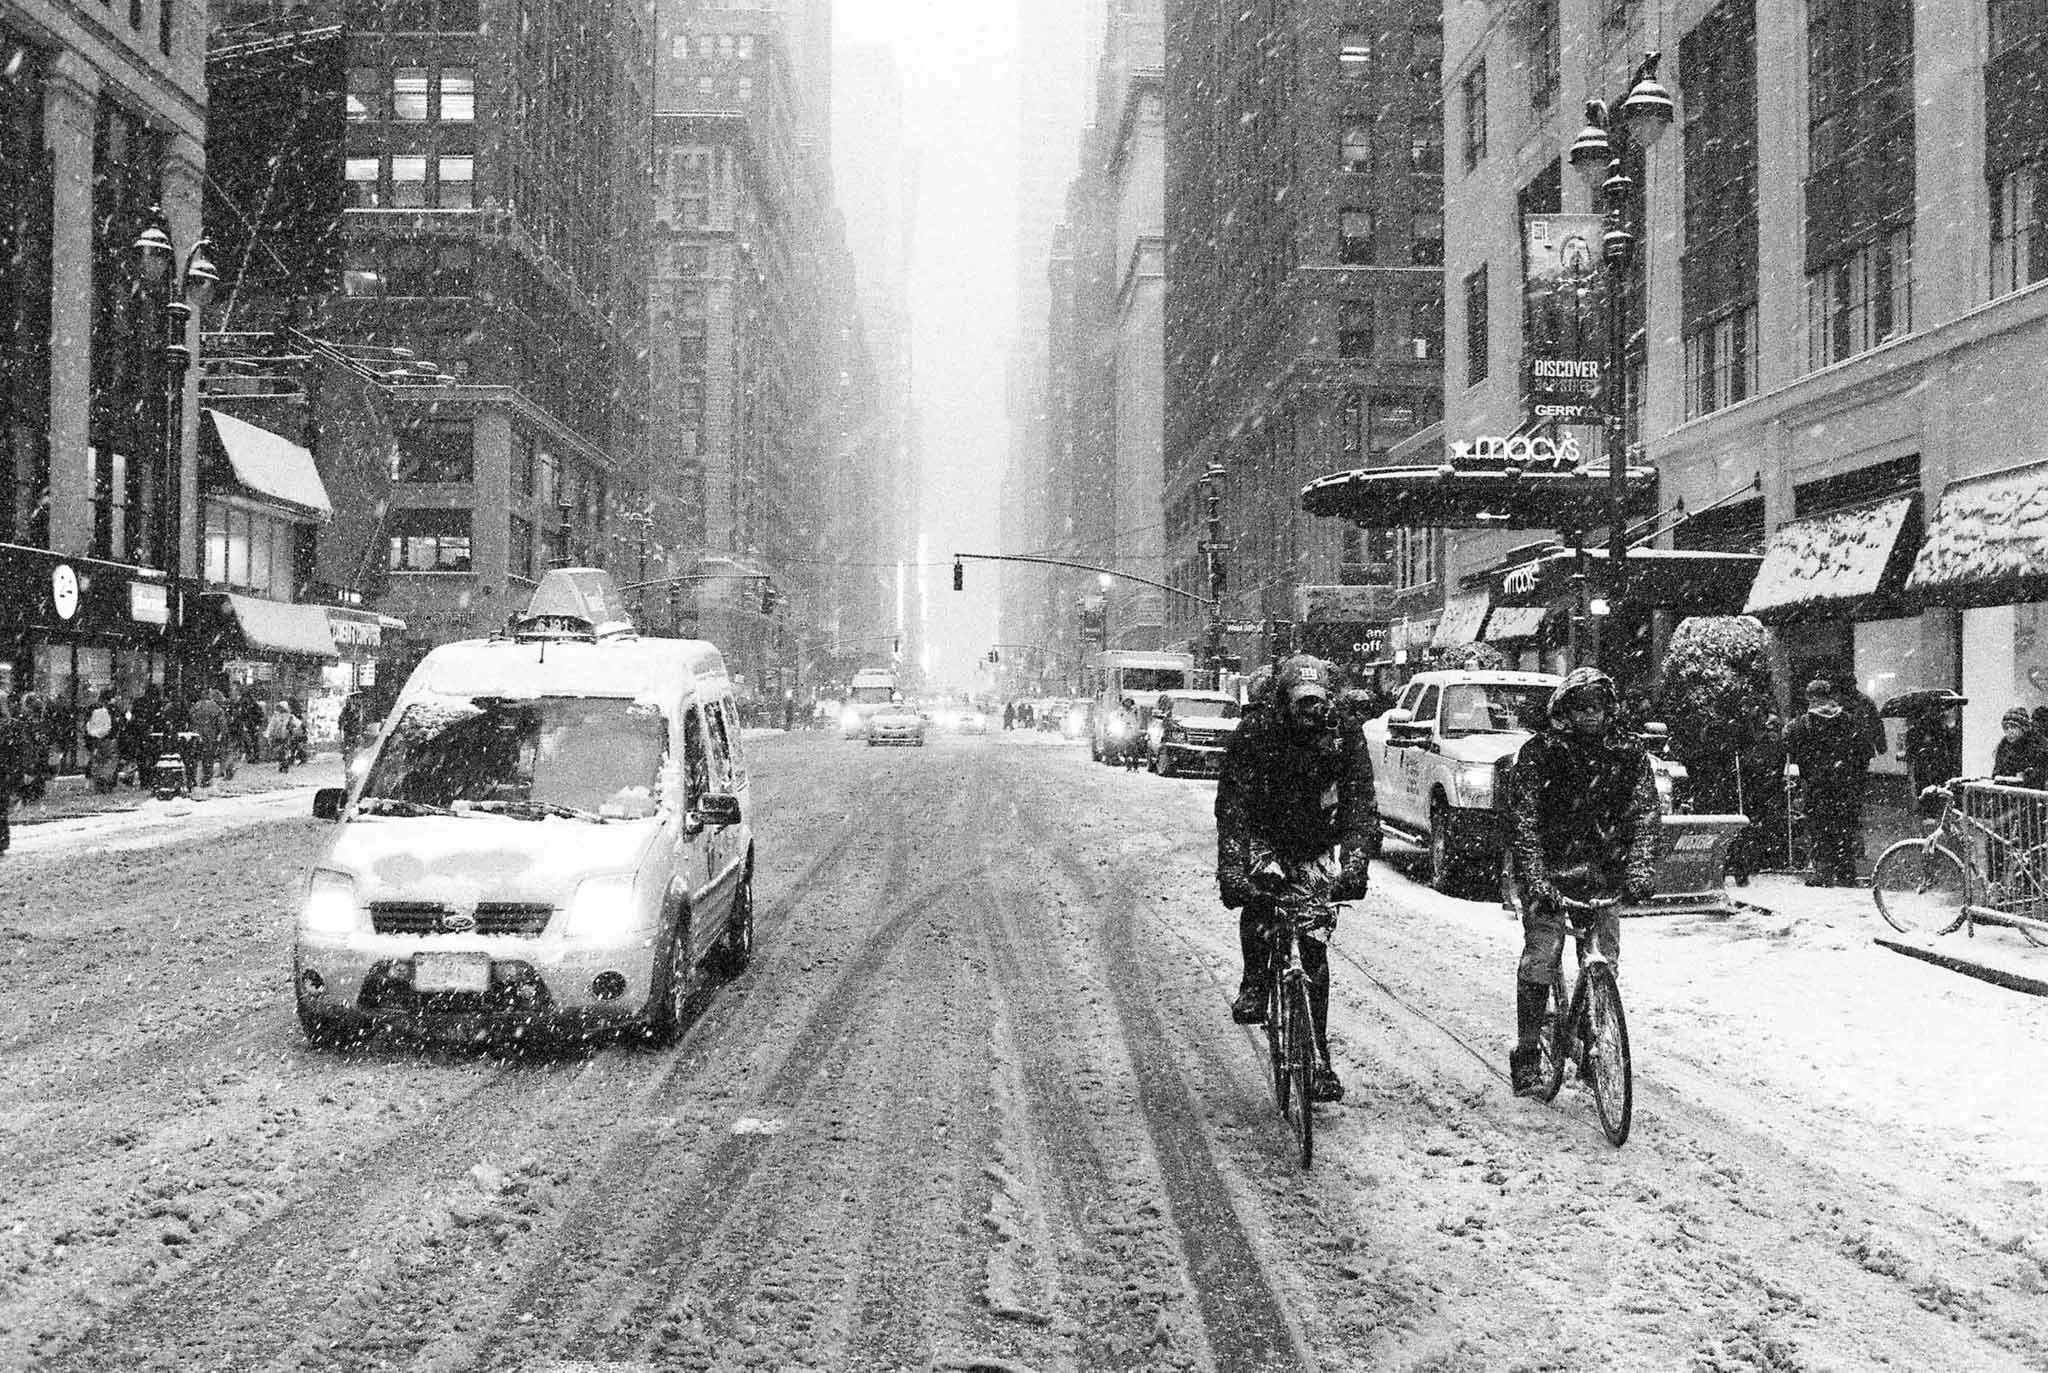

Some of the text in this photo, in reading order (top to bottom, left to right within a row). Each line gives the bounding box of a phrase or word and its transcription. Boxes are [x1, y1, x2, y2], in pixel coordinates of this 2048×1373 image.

[1534, 359, 1599, 378] DISCOVER
[1534, 404, 1583, 416] GERRY
[1353, 640, 1384, 652] coff
